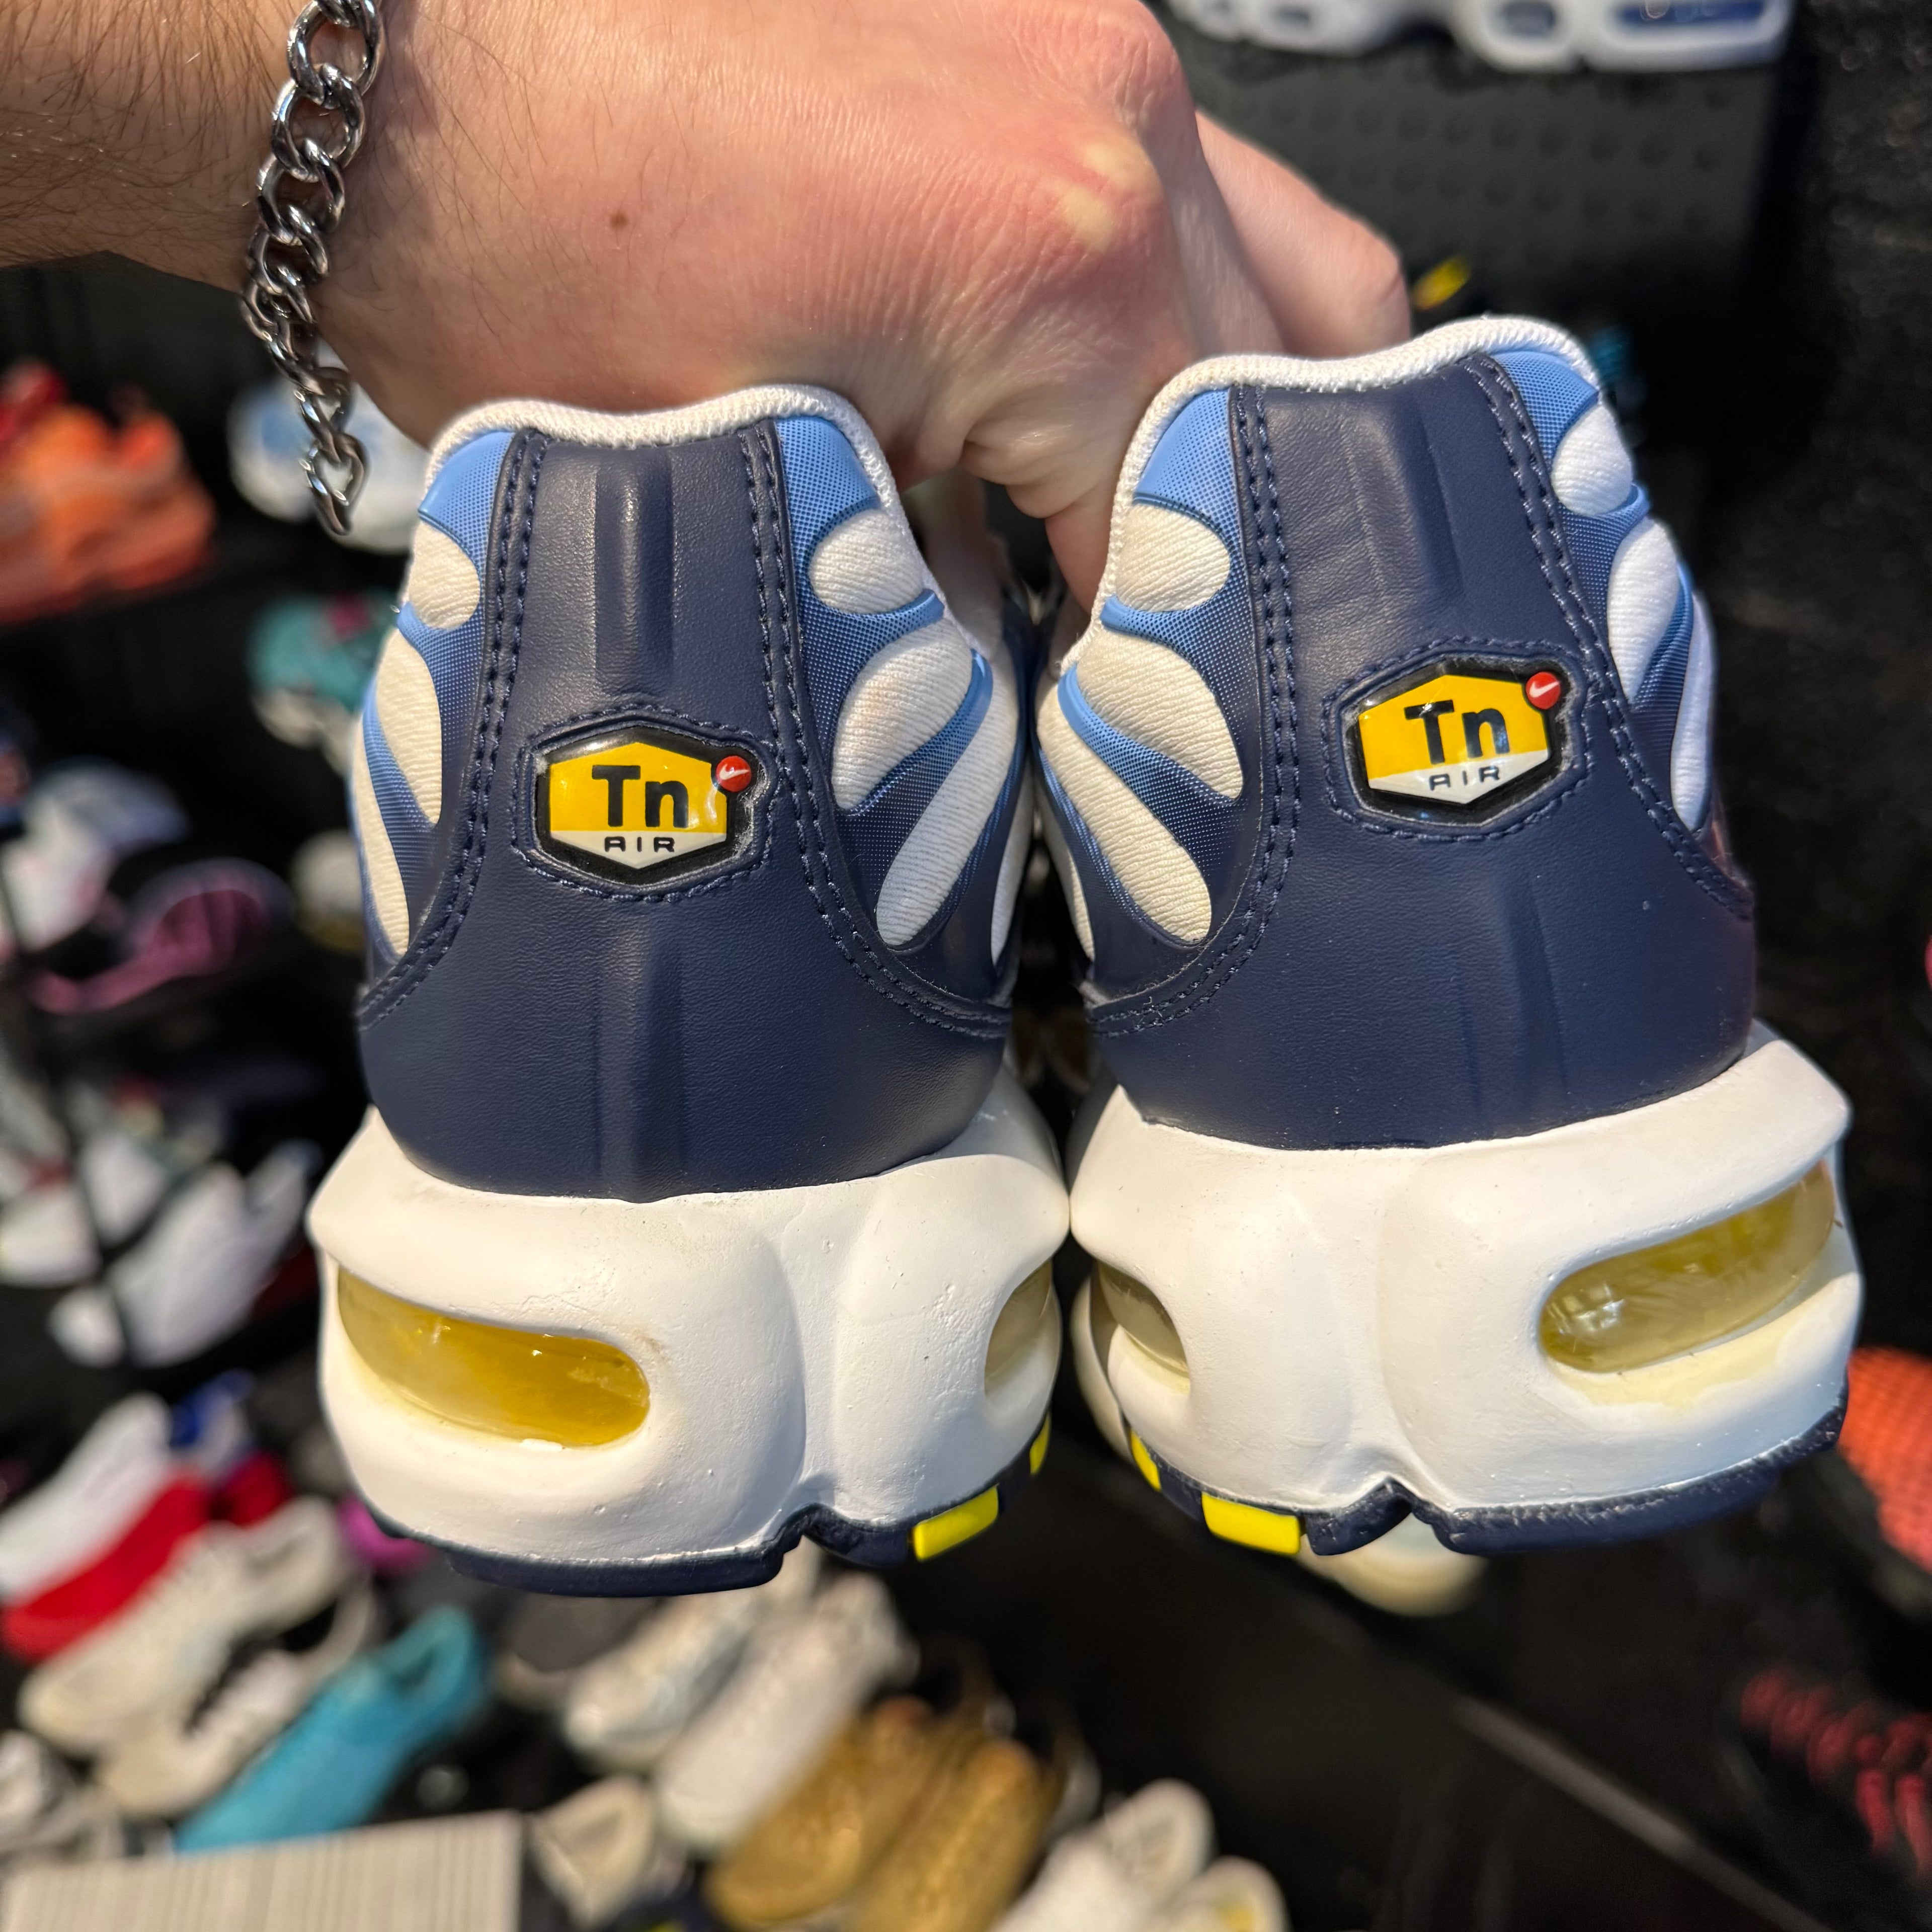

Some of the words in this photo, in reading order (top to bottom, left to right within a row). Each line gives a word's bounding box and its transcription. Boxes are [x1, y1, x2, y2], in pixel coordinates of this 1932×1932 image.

[1404, 700, 1510, 765] Tn
[592, 765, 689, 828] Tn
[1429, 766, 1501, 790] AIR
[604, 836, 675, 853] AIR
